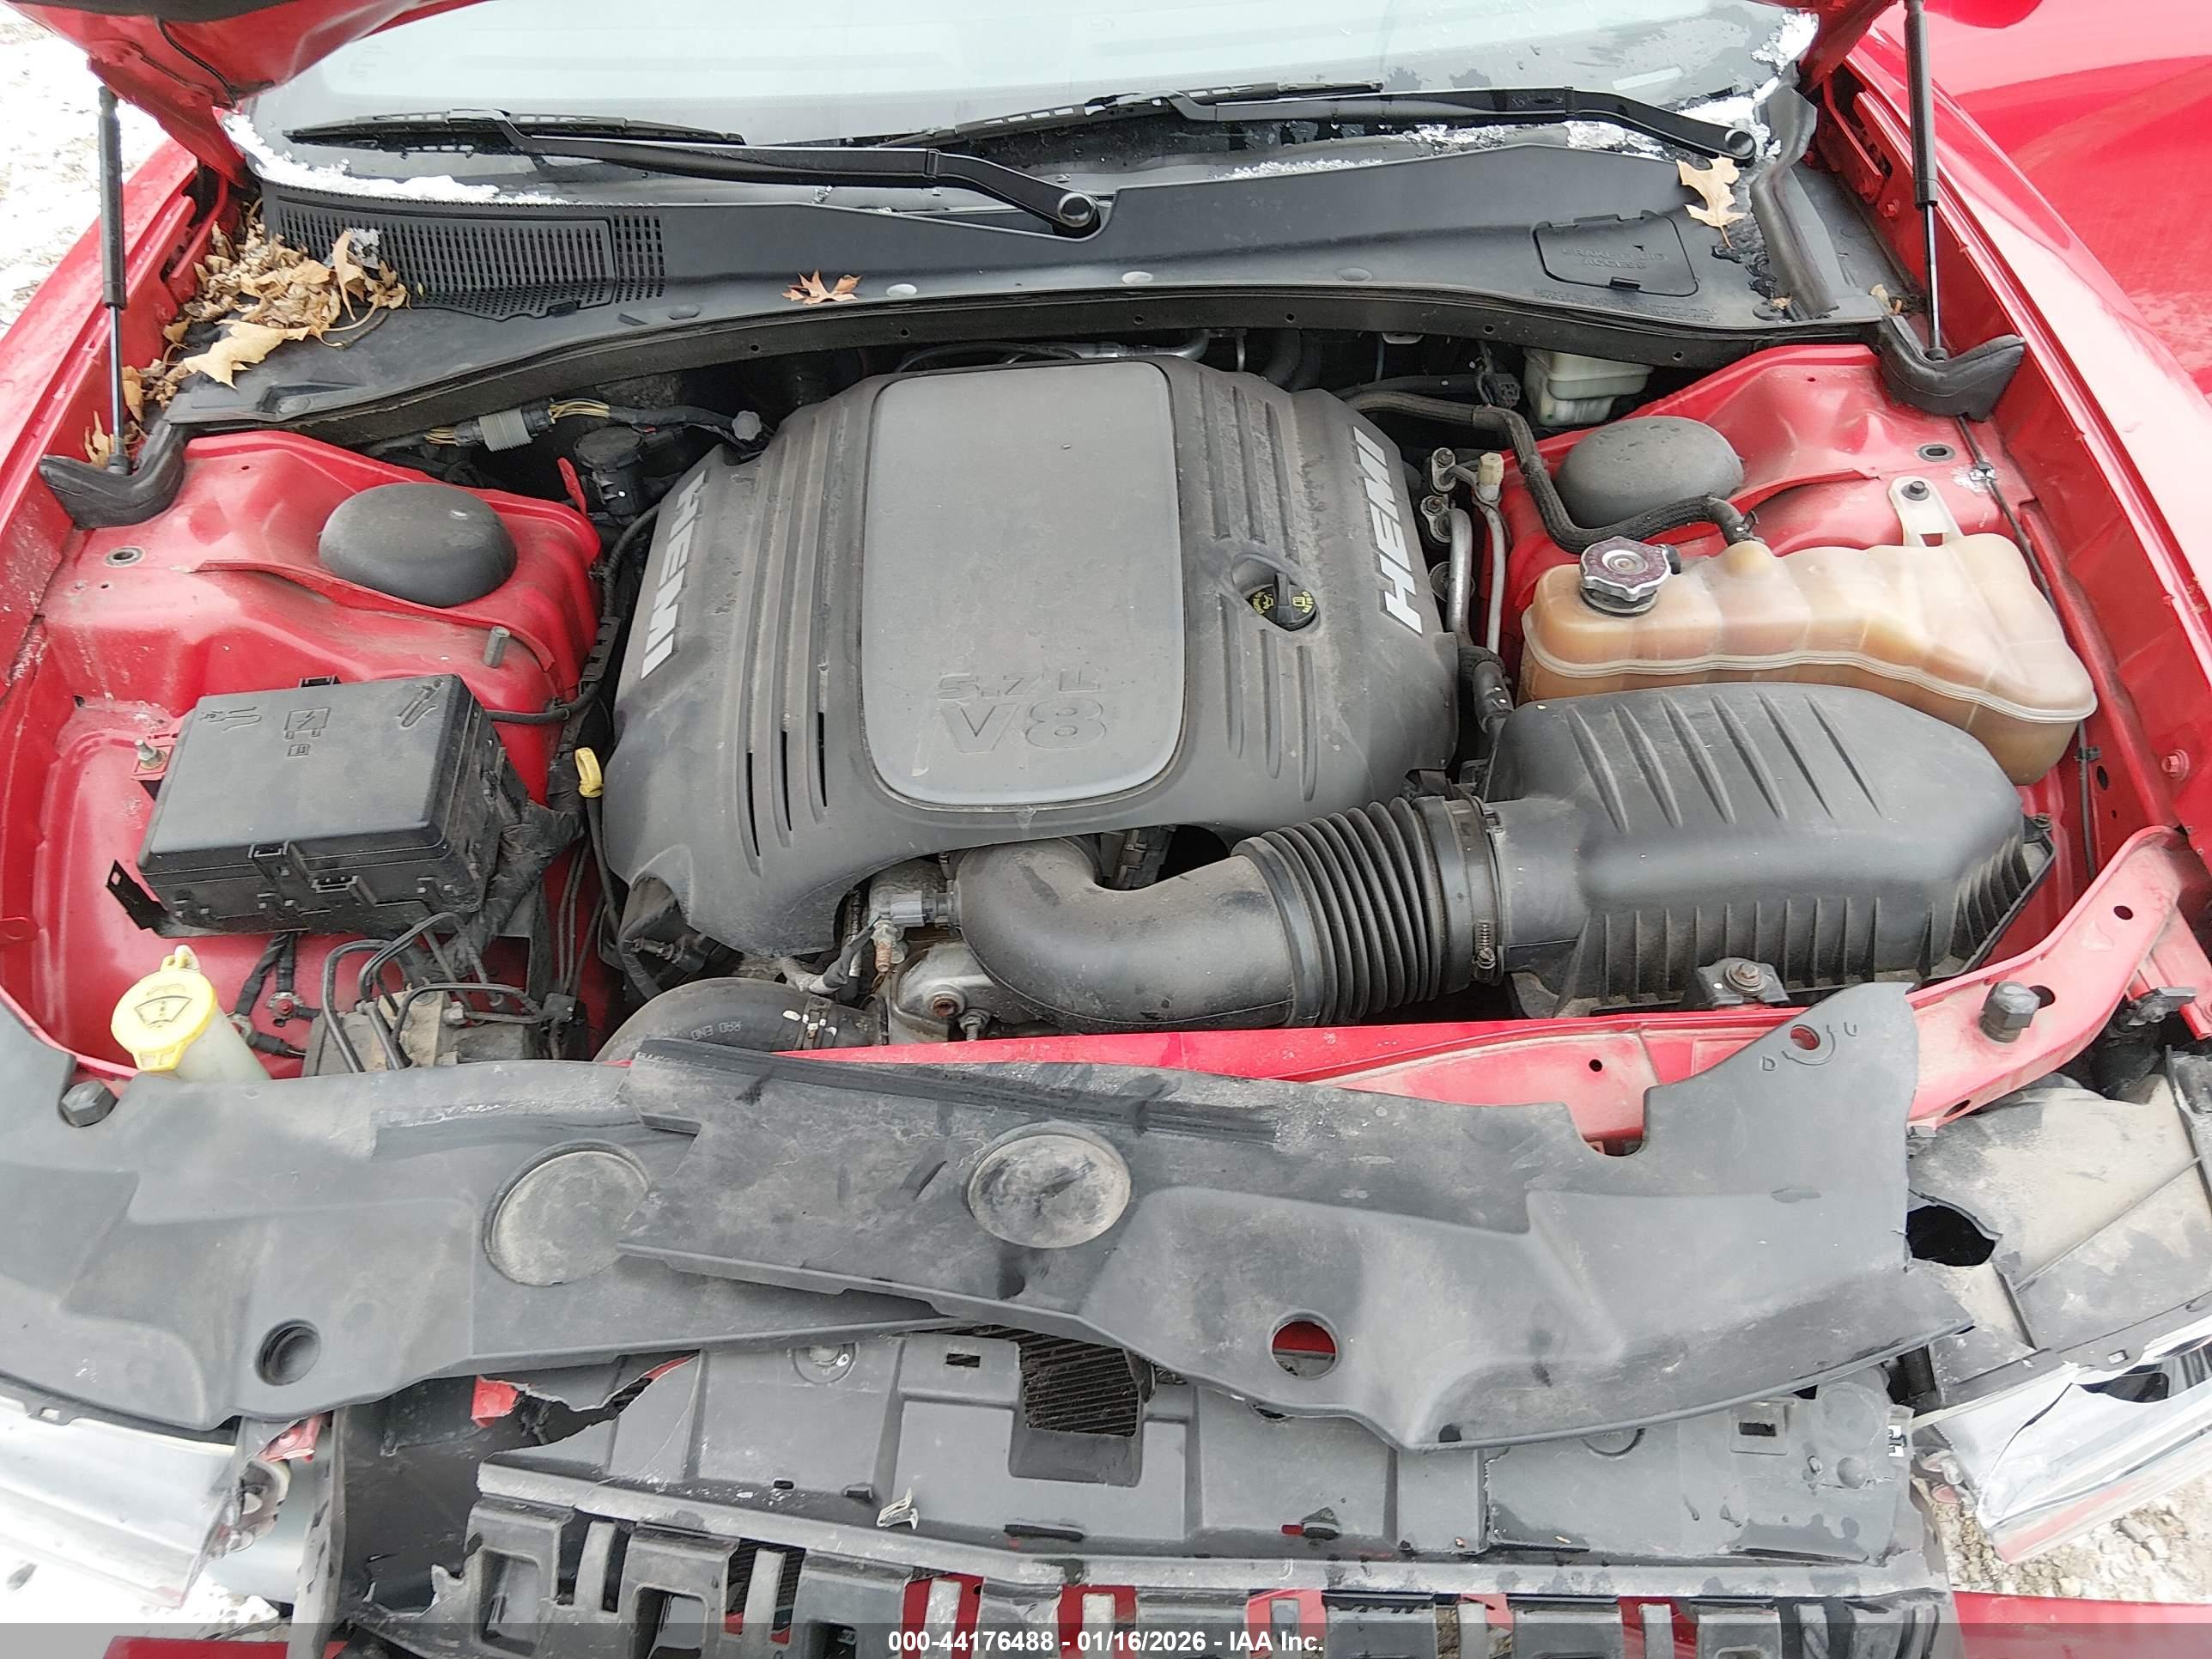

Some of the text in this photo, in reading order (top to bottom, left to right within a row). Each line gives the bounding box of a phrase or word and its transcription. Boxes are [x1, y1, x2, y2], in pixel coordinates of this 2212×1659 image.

[1583, 258, 1648, 270] ACCESS
[641, 469, 706, 680] HEMI
[1352, 425, 1423, 636] HEMI
[940, 698, 1108, 754] V8
